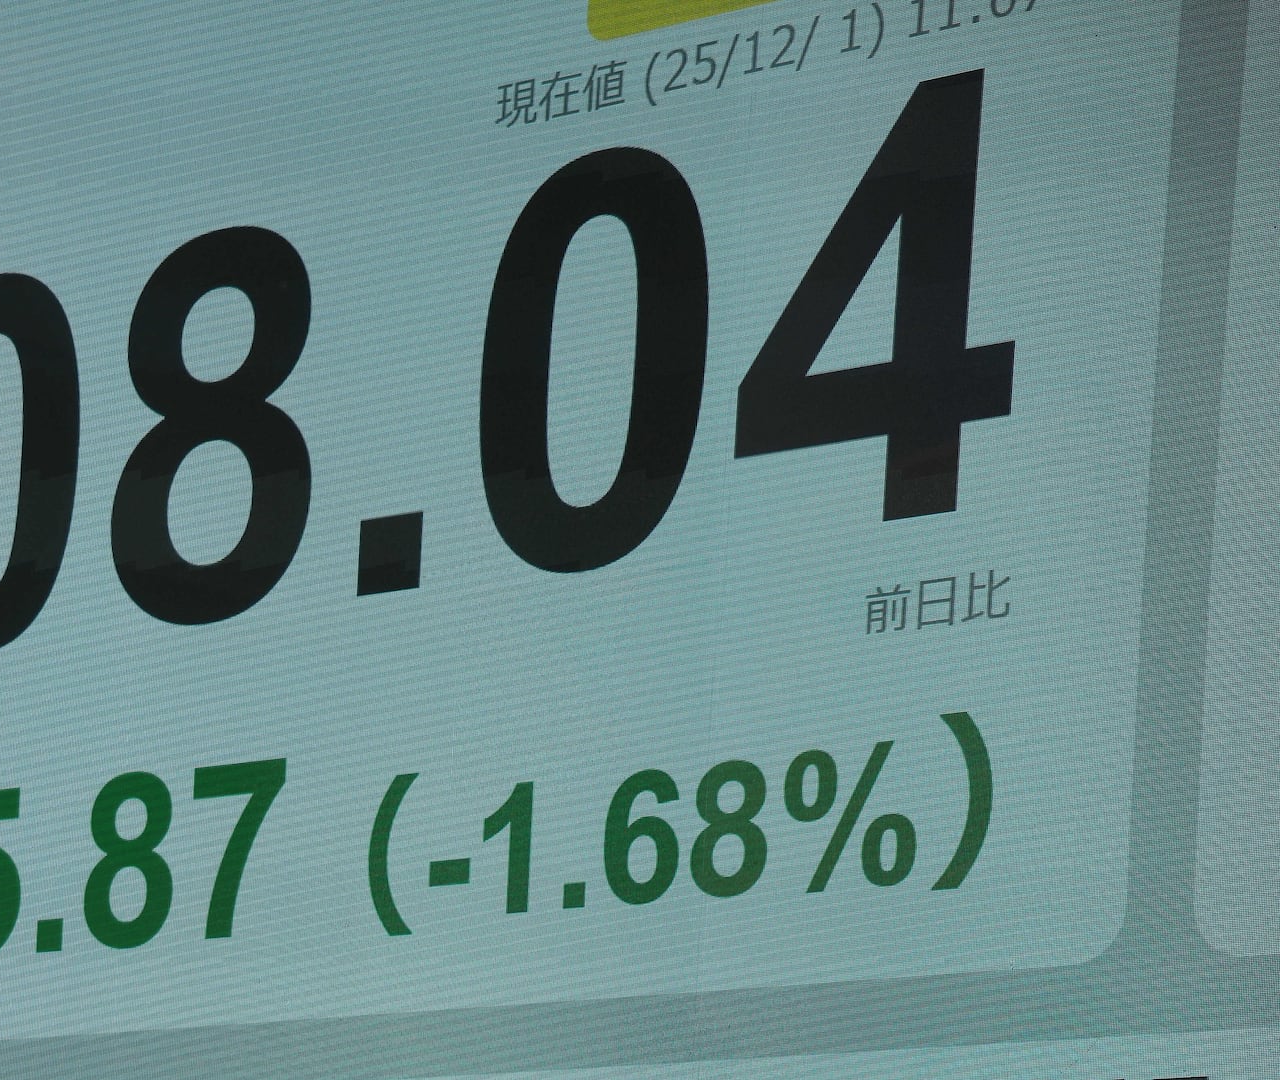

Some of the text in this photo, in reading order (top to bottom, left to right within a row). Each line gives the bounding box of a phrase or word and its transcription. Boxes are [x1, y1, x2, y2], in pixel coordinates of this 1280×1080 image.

[495, 60, 627, 128] 現在値
[865, 569, 1012, 635] 前日比
